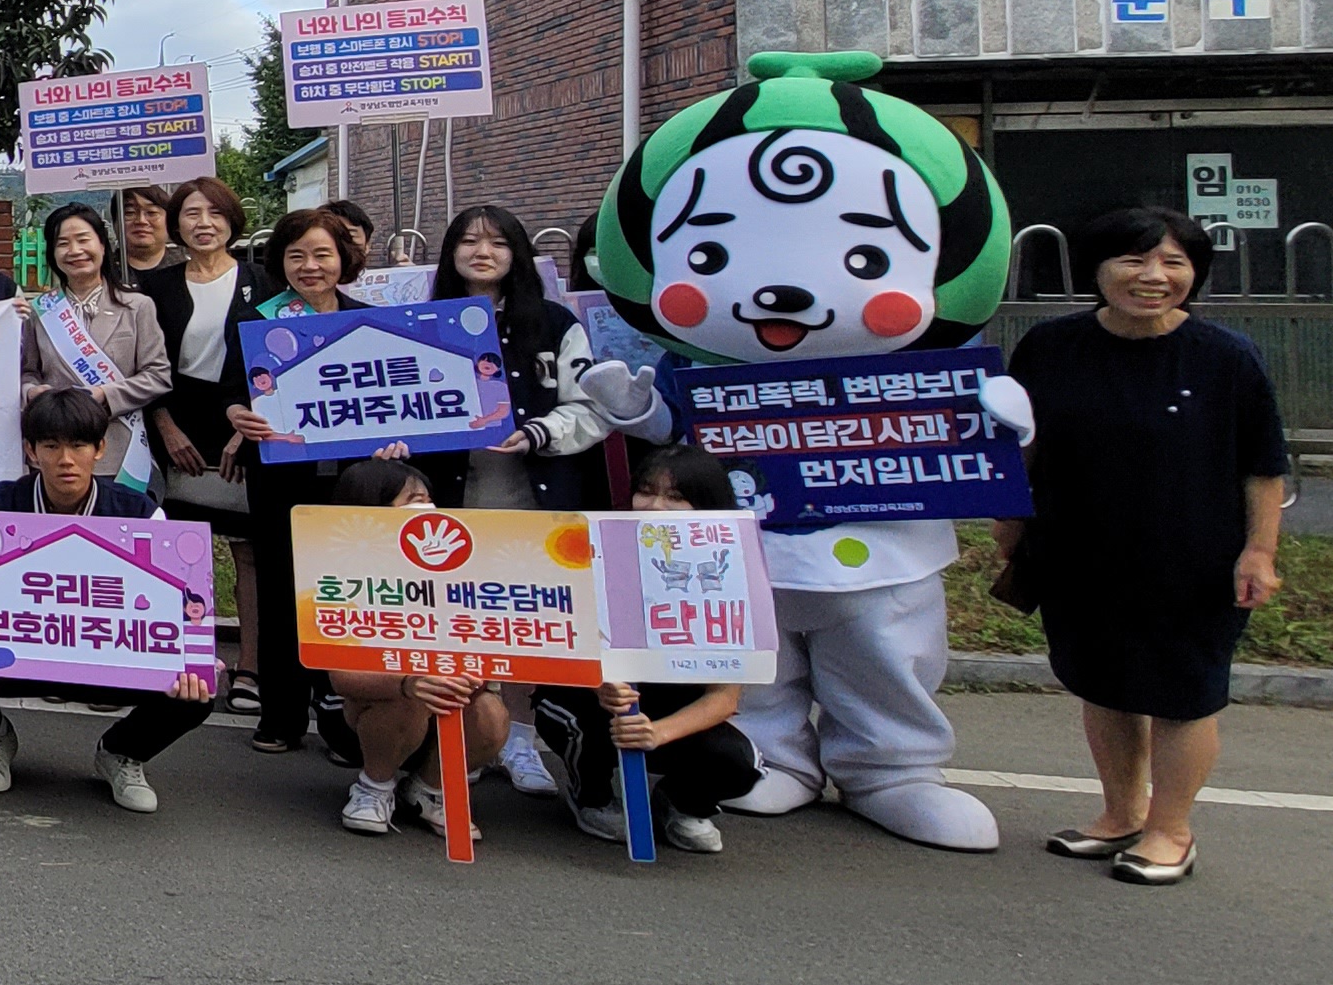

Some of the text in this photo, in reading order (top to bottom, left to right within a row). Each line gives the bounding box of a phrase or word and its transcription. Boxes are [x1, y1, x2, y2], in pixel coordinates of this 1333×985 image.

[298, 4, 468, 36] 너와 나의 등교수칙
[338, 38, 386, 54] 스마트폰
[389, 35, 413, 49] 잠시
[417, 31, 464, 47] STOP!
[299, 64, 323, 78] 승차
[340, 59, 388, 74] 안전벨트
[419, 51, 473, 68] START!
[35, 71, 192, 105] 너와 나의 등교수칙
[300, 84, 327, 99] 하차
[400, 75, 446, 91] STOP!
[144, 98, 188, 114] STOP!
[145, 118, 197, 135] START!
[36, 152, 60, 165] 하차
[128, 142, 171, 158] STOP!
[1236, 209, 1271, 220] 6917
[318, 356, 422, 391] 우리를
[691, 368, 988, 413] 학교폭력, 변명보다
[799, 453, 1005, 488] 먼저입니다.
[21, 571, 125, 609] 우리를
[316, 575, 574, 615] 호기심에 배운담배
[315, 608, 578, 650] 평생동안 후회한다
[649, 598, 745, 646] 담배
[382, 650, 513, 678] 칠원중학교
